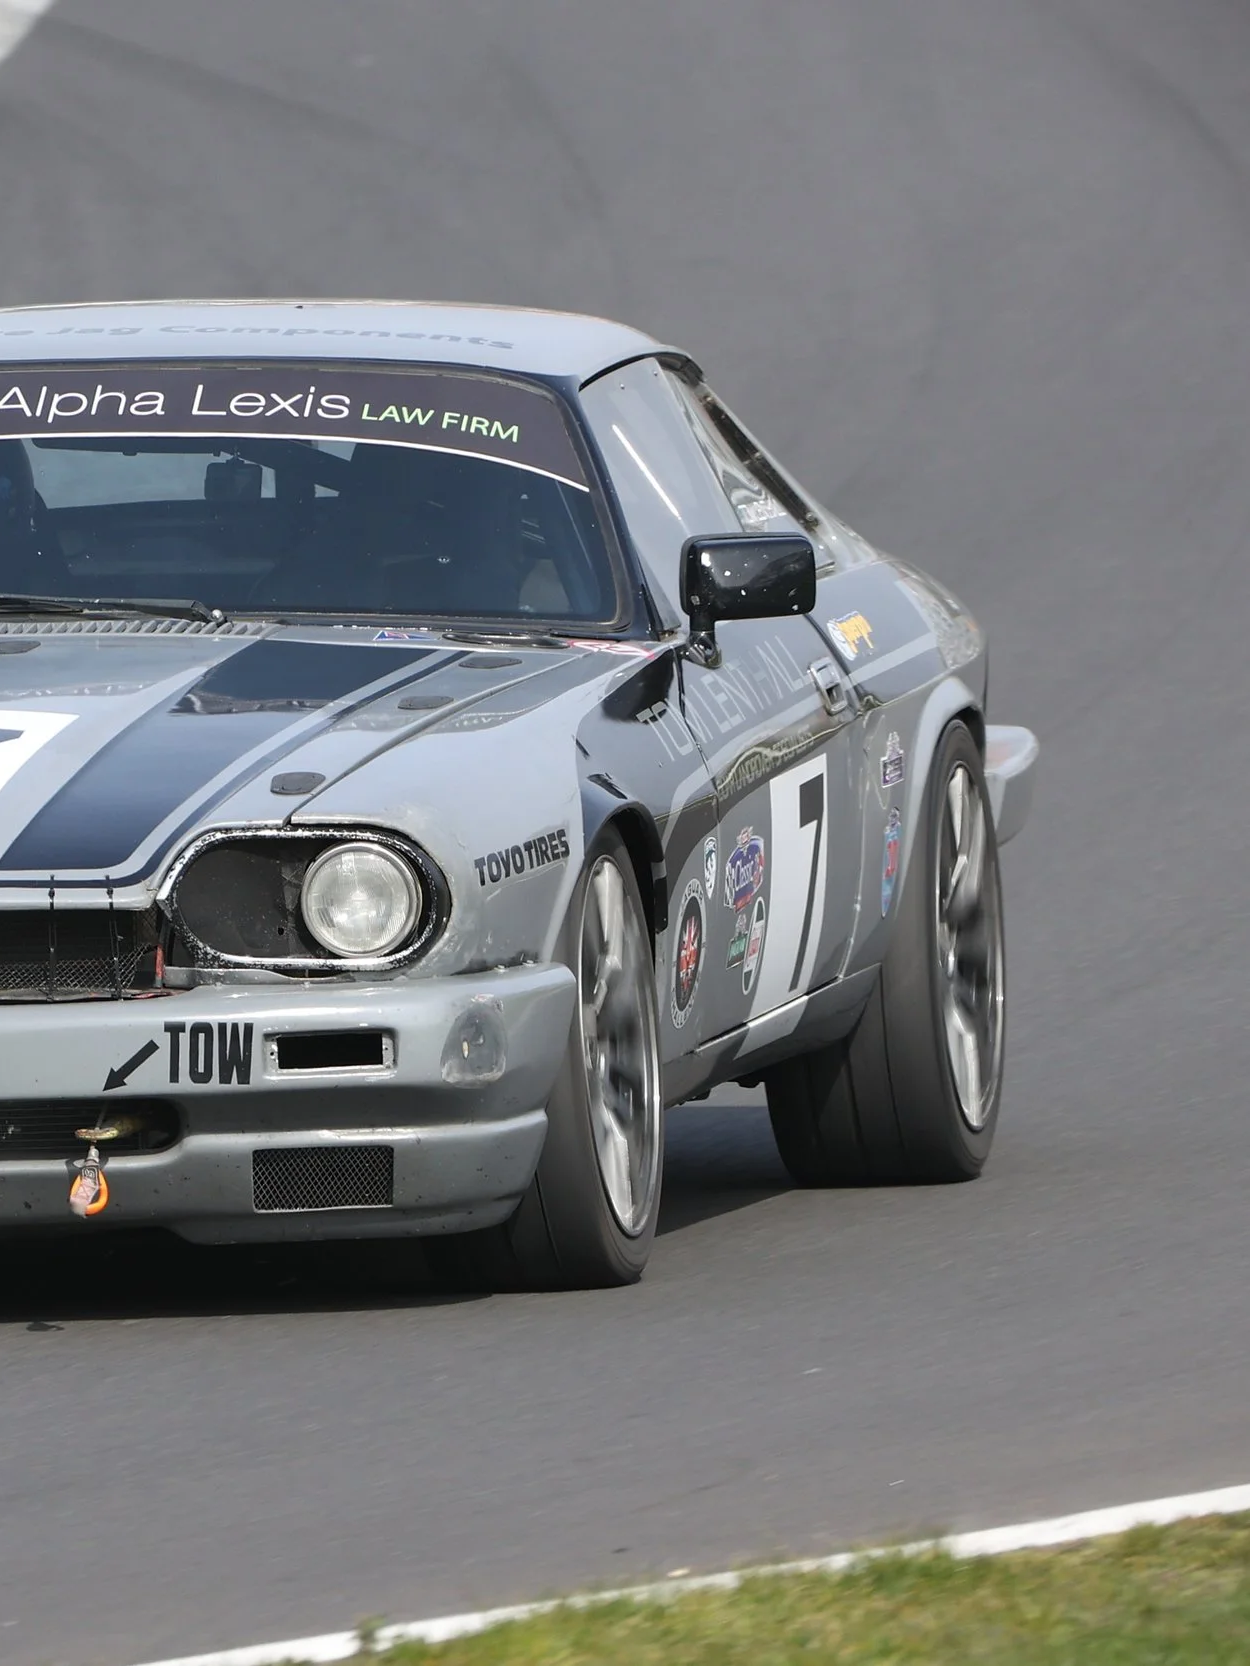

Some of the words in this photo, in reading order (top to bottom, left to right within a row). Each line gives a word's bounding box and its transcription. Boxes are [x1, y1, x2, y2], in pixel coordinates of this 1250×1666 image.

[46, 327, 144, 336] Jag
[159, 325, 515, 350] Components
[191, 384, 351, 419] Lexis
[361, 403, 435, 426] LAW
[442, 412, 520, 443] FIRM
[473, 844, 525, 887] TOYO
[523, 828, 570, 870] TIRES
[788, 772, 824, 993] 7
[163, 1020, 254, 1085] TOW
